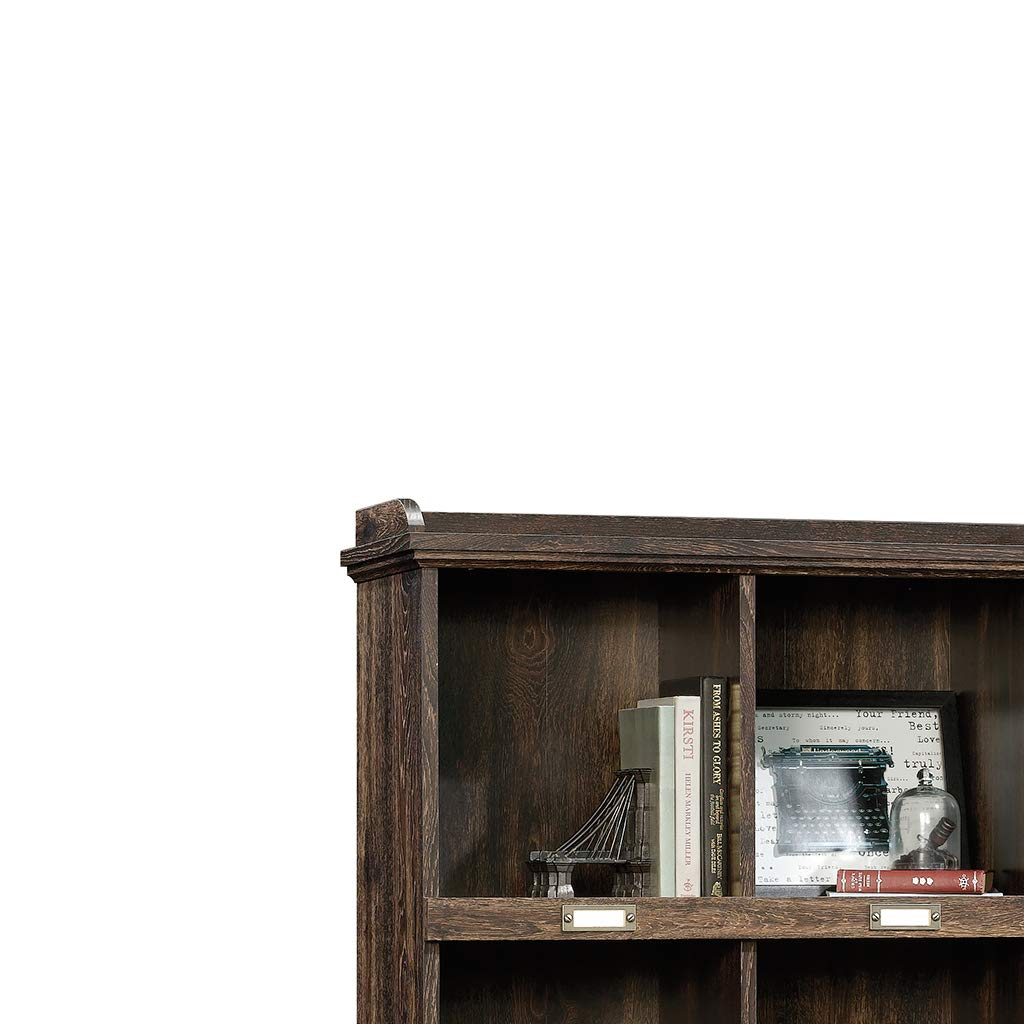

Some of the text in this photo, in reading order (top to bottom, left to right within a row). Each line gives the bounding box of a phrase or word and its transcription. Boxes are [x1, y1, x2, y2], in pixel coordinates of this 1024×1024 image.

[856, 710, 883, 718] Your
[908, 721, 940, 731] Best
[683, 709, 694, 760] KIRSTI
[713, 684, 721, 785] FROM ASHES TO GLORY
[917, 735, 940, 743] Love
[904, 758, 942, 770] truly
